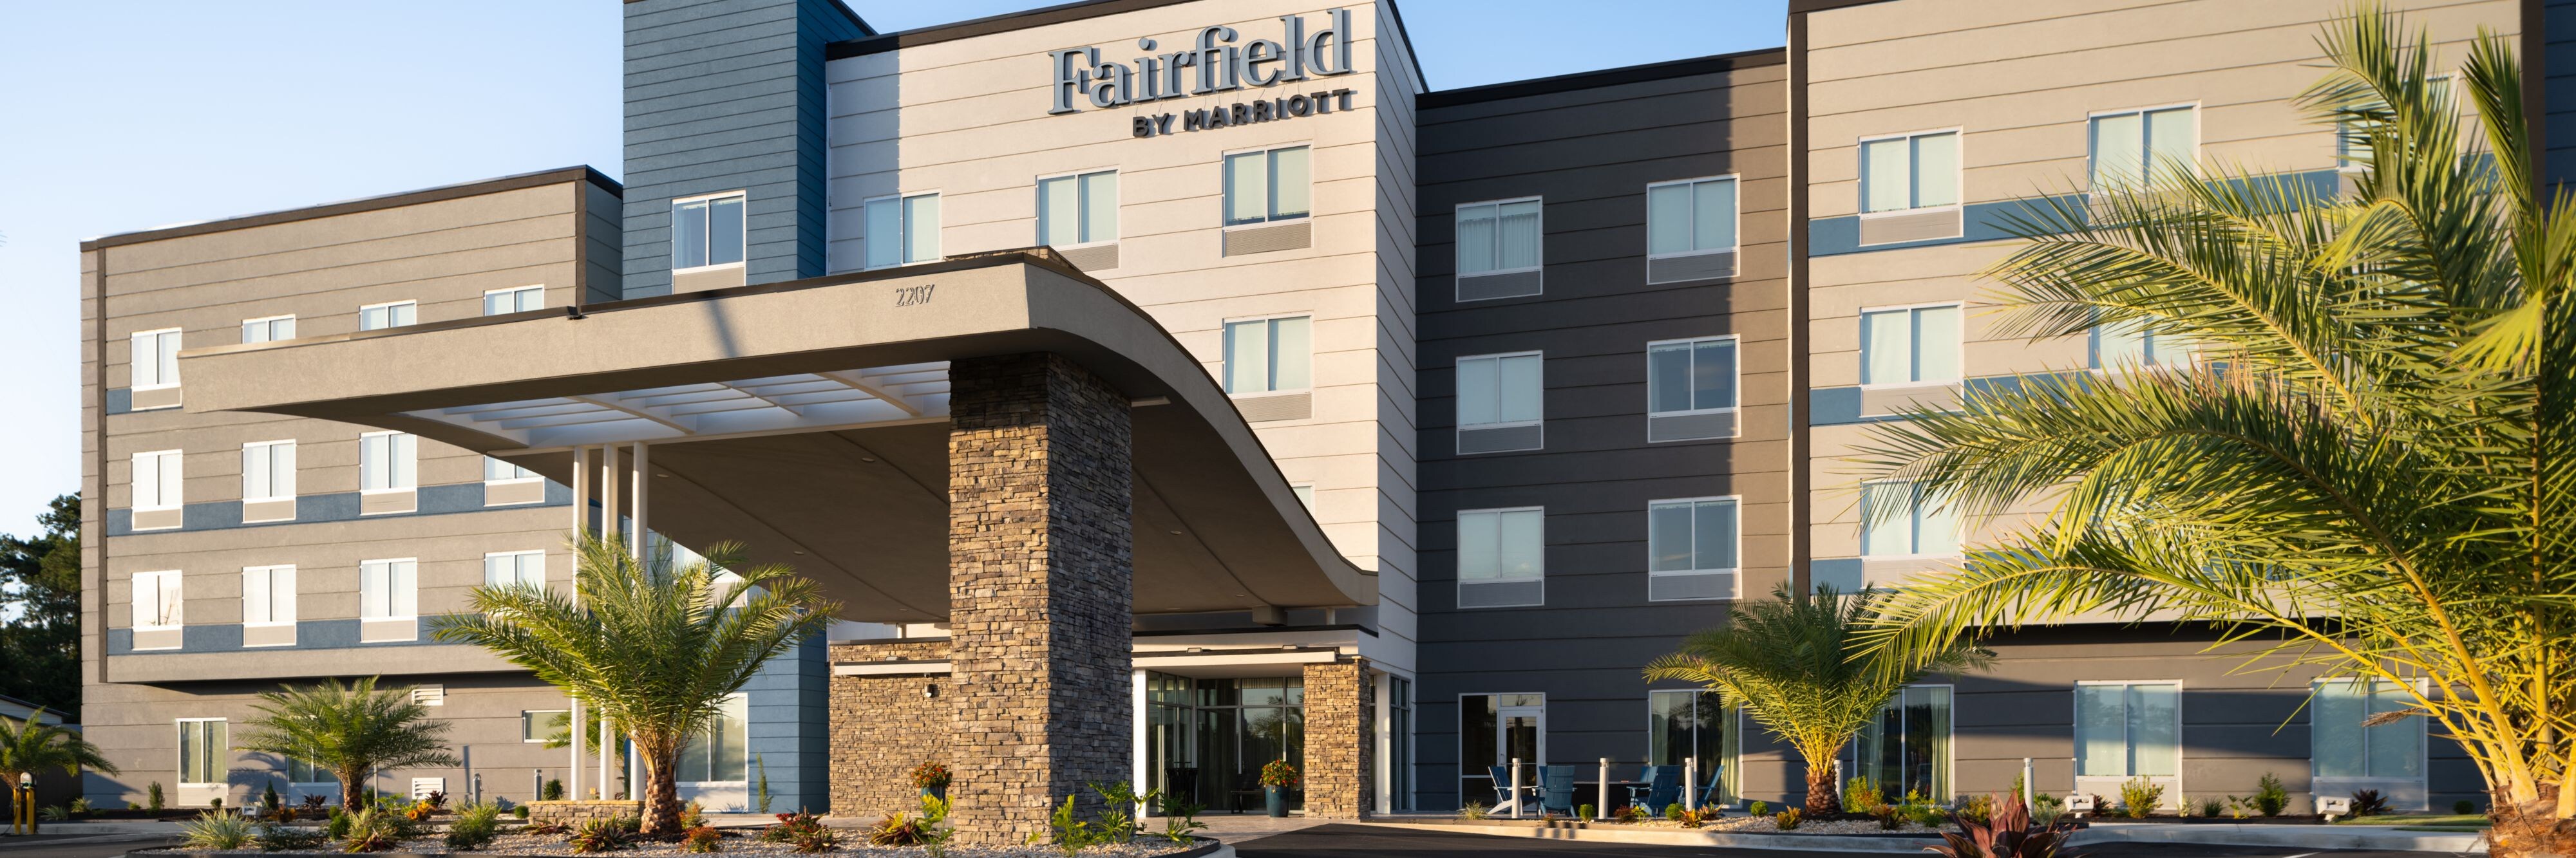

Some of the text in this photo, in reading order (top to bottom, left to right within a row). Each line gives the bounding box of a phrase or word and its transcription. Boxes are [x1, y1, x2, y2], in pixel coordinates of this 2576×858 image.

[1047, 8, 1349, 115] Fairfield
[1132, 88, 1350, 137] BY MARRIOTT
[896, 284, 935, 307] 2207
